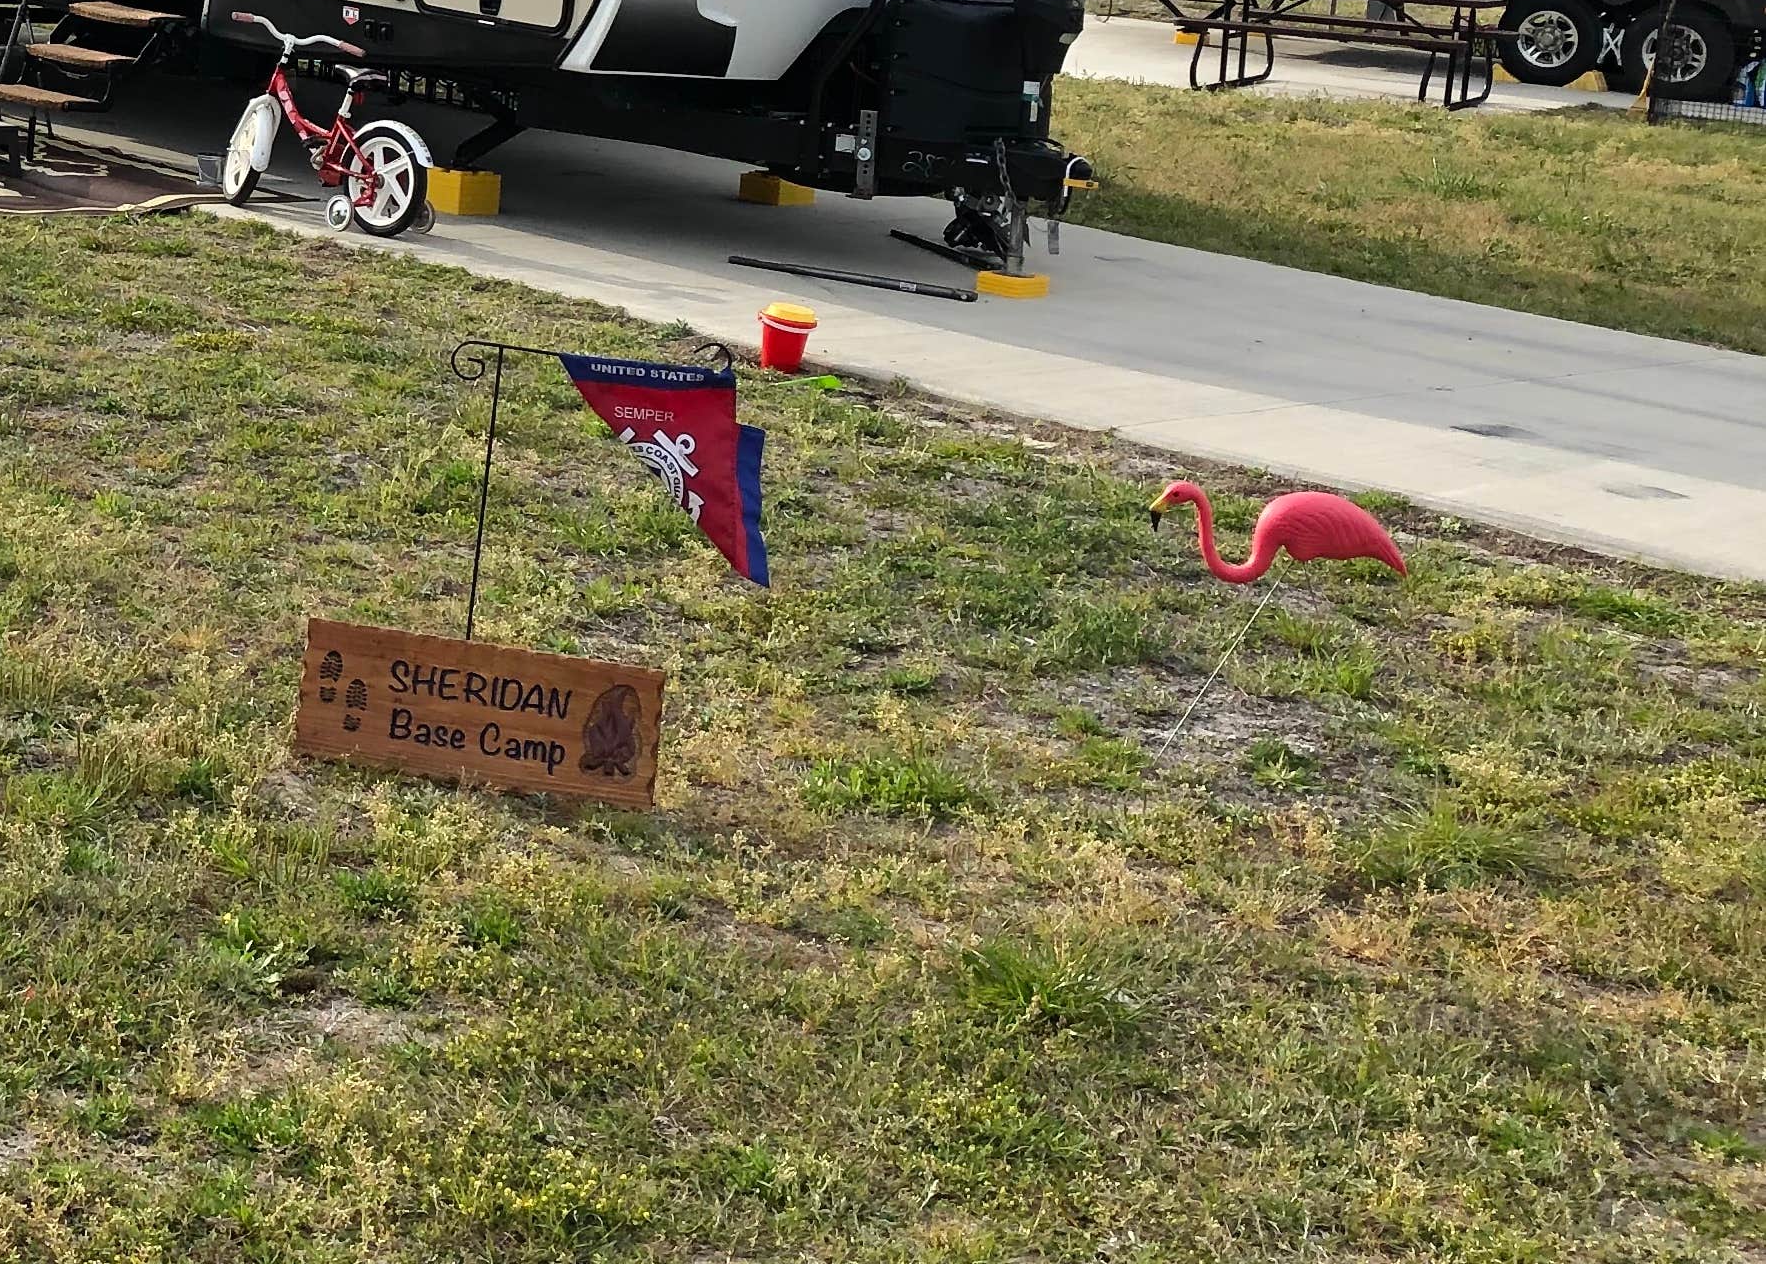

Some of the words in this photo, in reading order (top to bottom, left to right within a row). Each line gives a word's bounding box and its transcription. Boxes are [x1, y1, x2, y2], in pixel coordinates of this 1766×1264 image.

[590, 363, 645, 377] UNITED
[650, 369, 705, 382] STATES
[614, 406, 674, 422] SEMPER
[646, 446, 678, 475] COAST
[388, 659, 573, 720] SHERIDAN
[389, 707, 466, 749] Base
[479, 721, 566, 776] Camp
